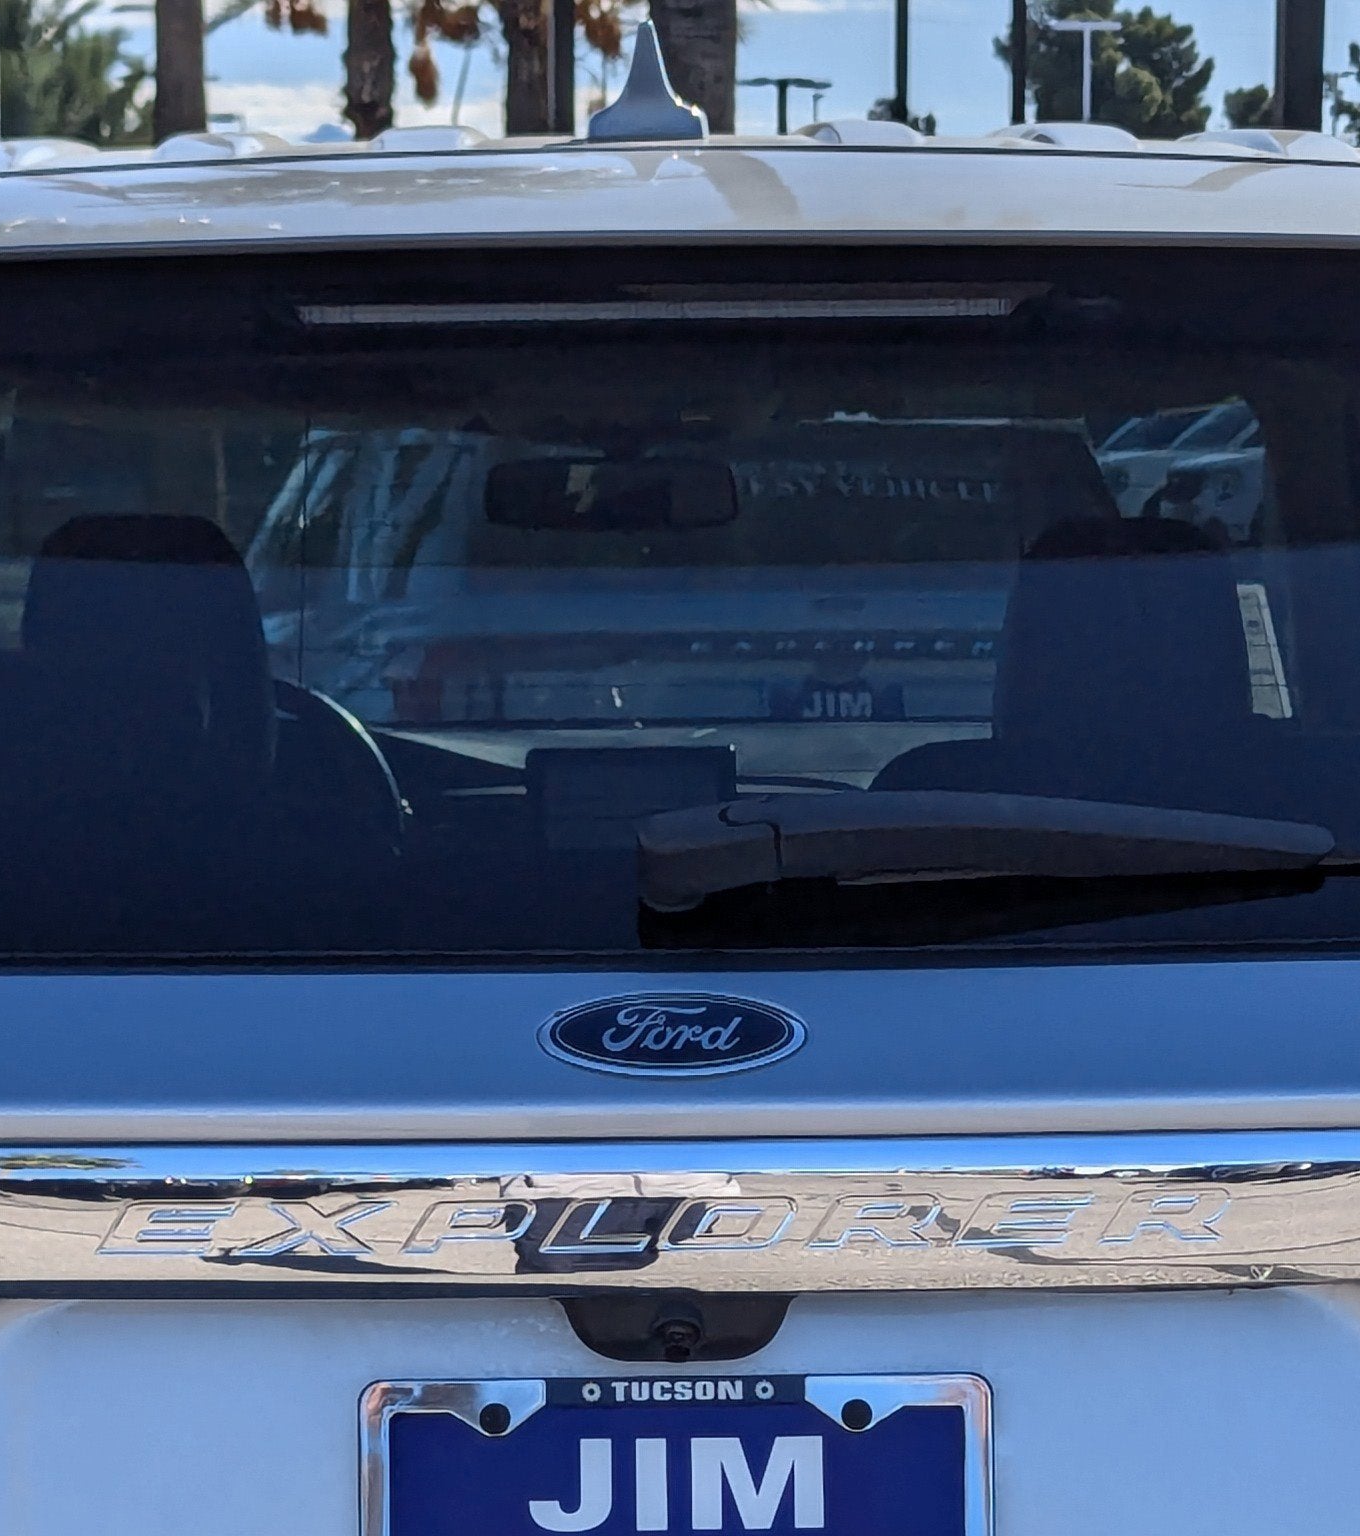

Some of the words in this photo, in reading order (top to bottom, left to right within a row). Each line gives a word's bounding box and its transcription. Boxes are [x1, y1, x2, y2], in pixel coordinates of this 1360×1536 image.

[803, 691, 872, 717] JIM
[602, 1005, 742, 1051] Ford
[94, 1187, 1234, 1257] EXPLORER
[611, 1380, 744, 1402] TUCSON
[528, 1435, 825, 1532] JIM
